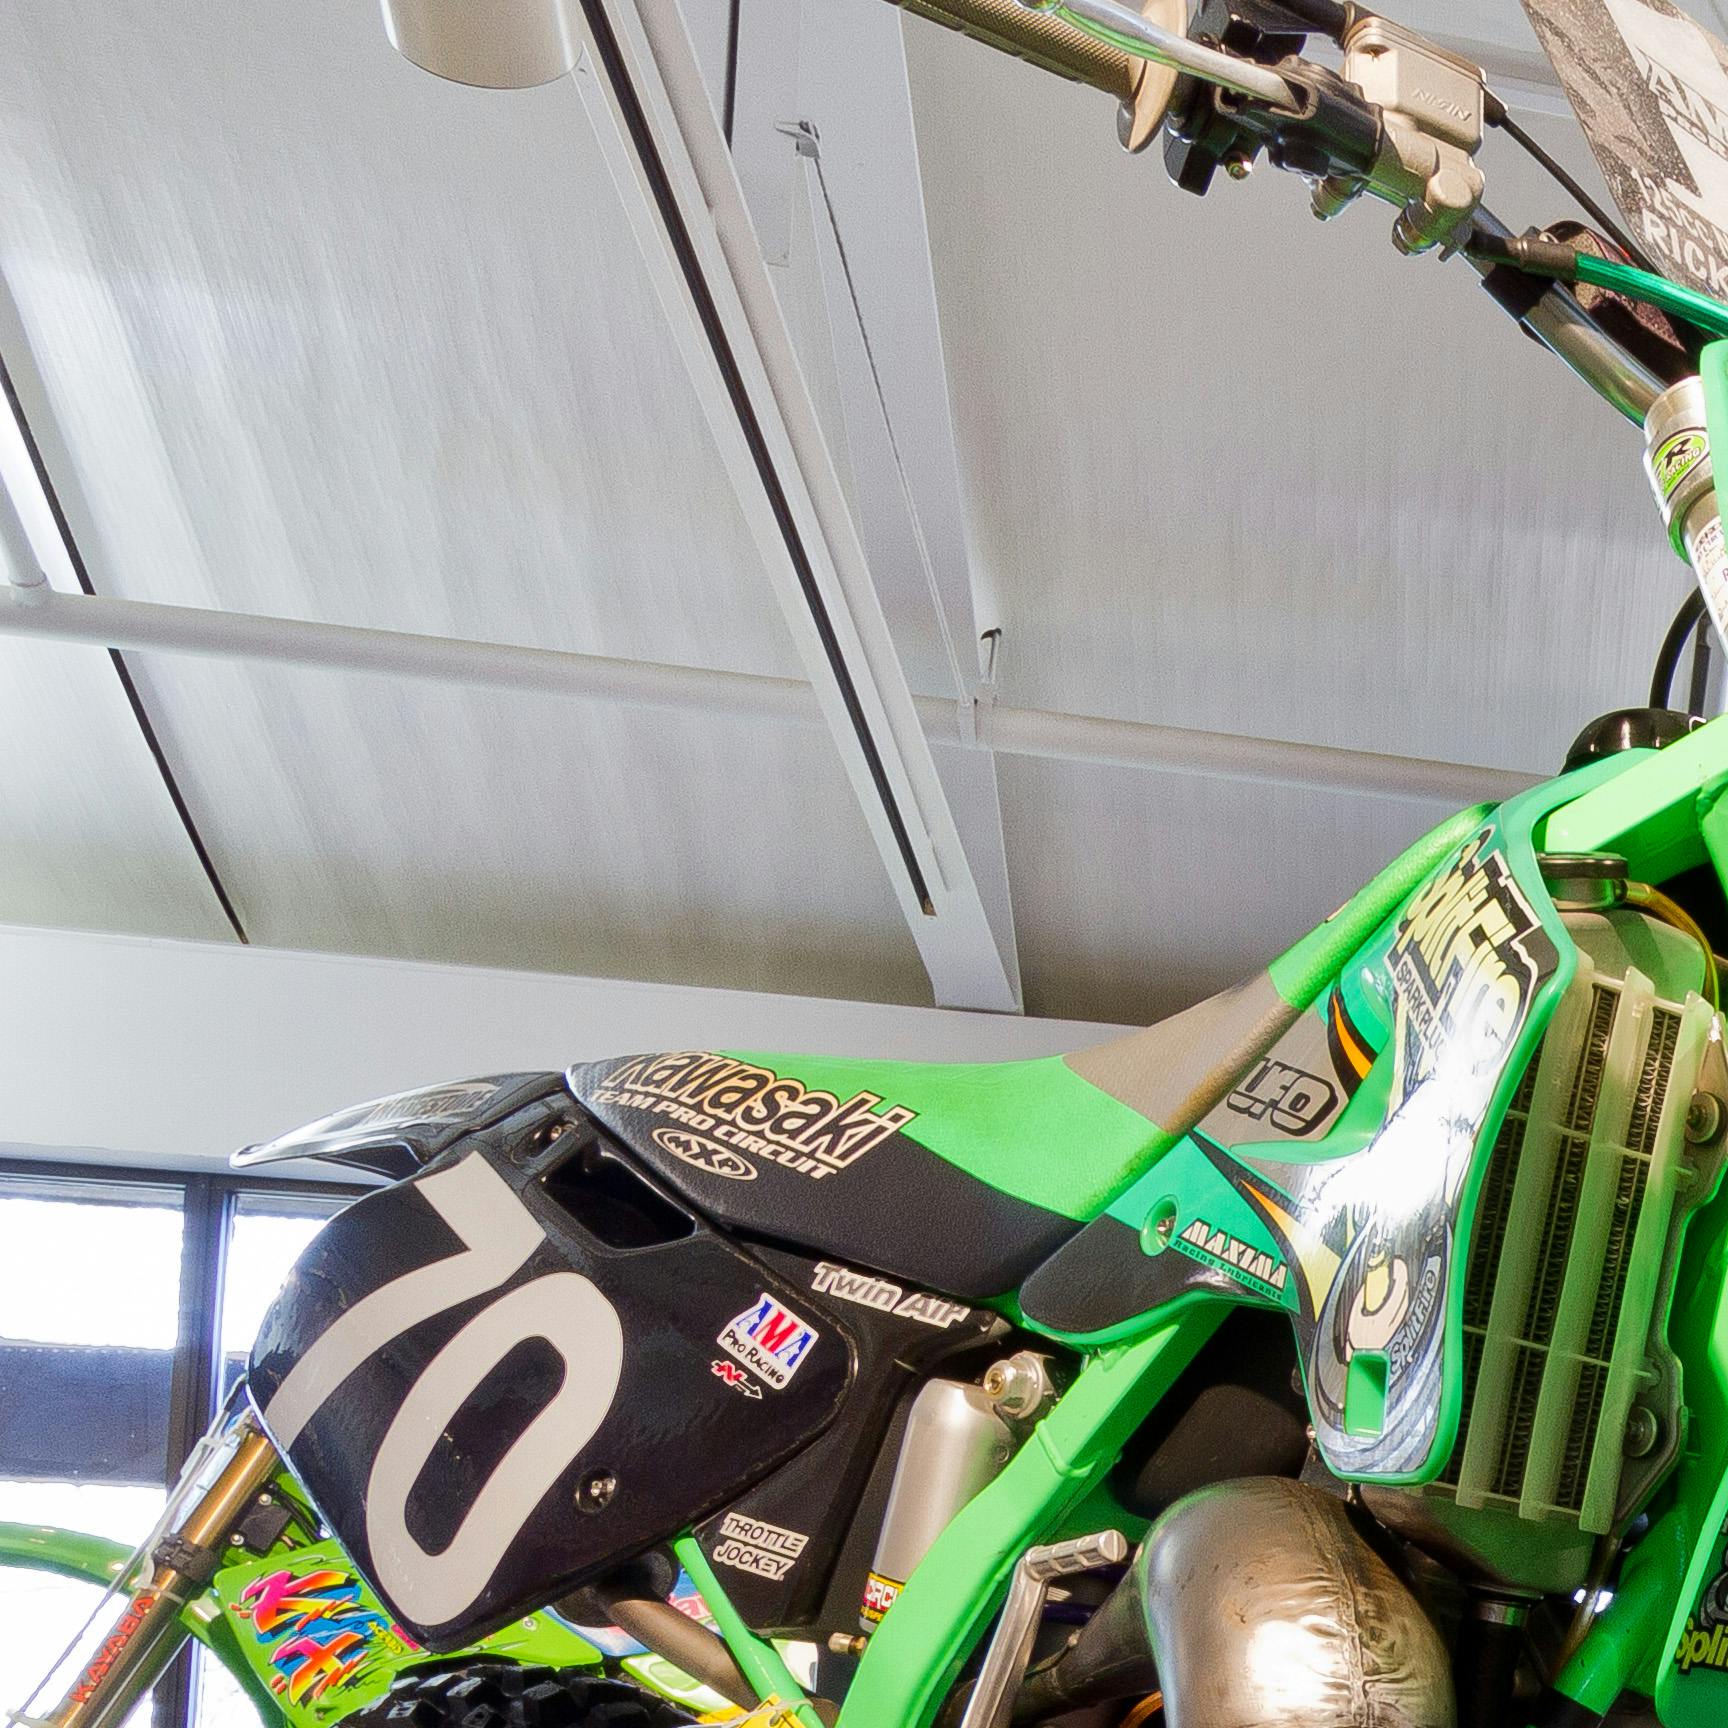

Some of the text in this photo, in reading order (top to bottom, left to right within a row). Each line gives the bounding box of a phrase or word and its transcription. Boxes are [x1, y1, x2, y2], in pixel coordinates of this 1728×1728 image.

[593, 1088, 652, 1114] TEAM
[652, 1098, 710, 1132] PRO
[711, 1122, 838, 1181] CIRCUIT
[604, 1050, 917, 1168] Kawasaki
[811, 1261, 902, 1313] Twin
[1172, 1239, 1283, 1301] Racing Lubricants
[1178, 1218, 1289, 1291] MAXIMA
[736, 1300, 812, 1368] AMA
[744, 1349, 785, 1384] RACING
[270, 1150, 623, 1626] 70
[716, 1541, 793, 1579] JOCKEY
[724, 1515, 807, 1554] THROTTLE
[68, 1595, 156, 1704] KAYABA
